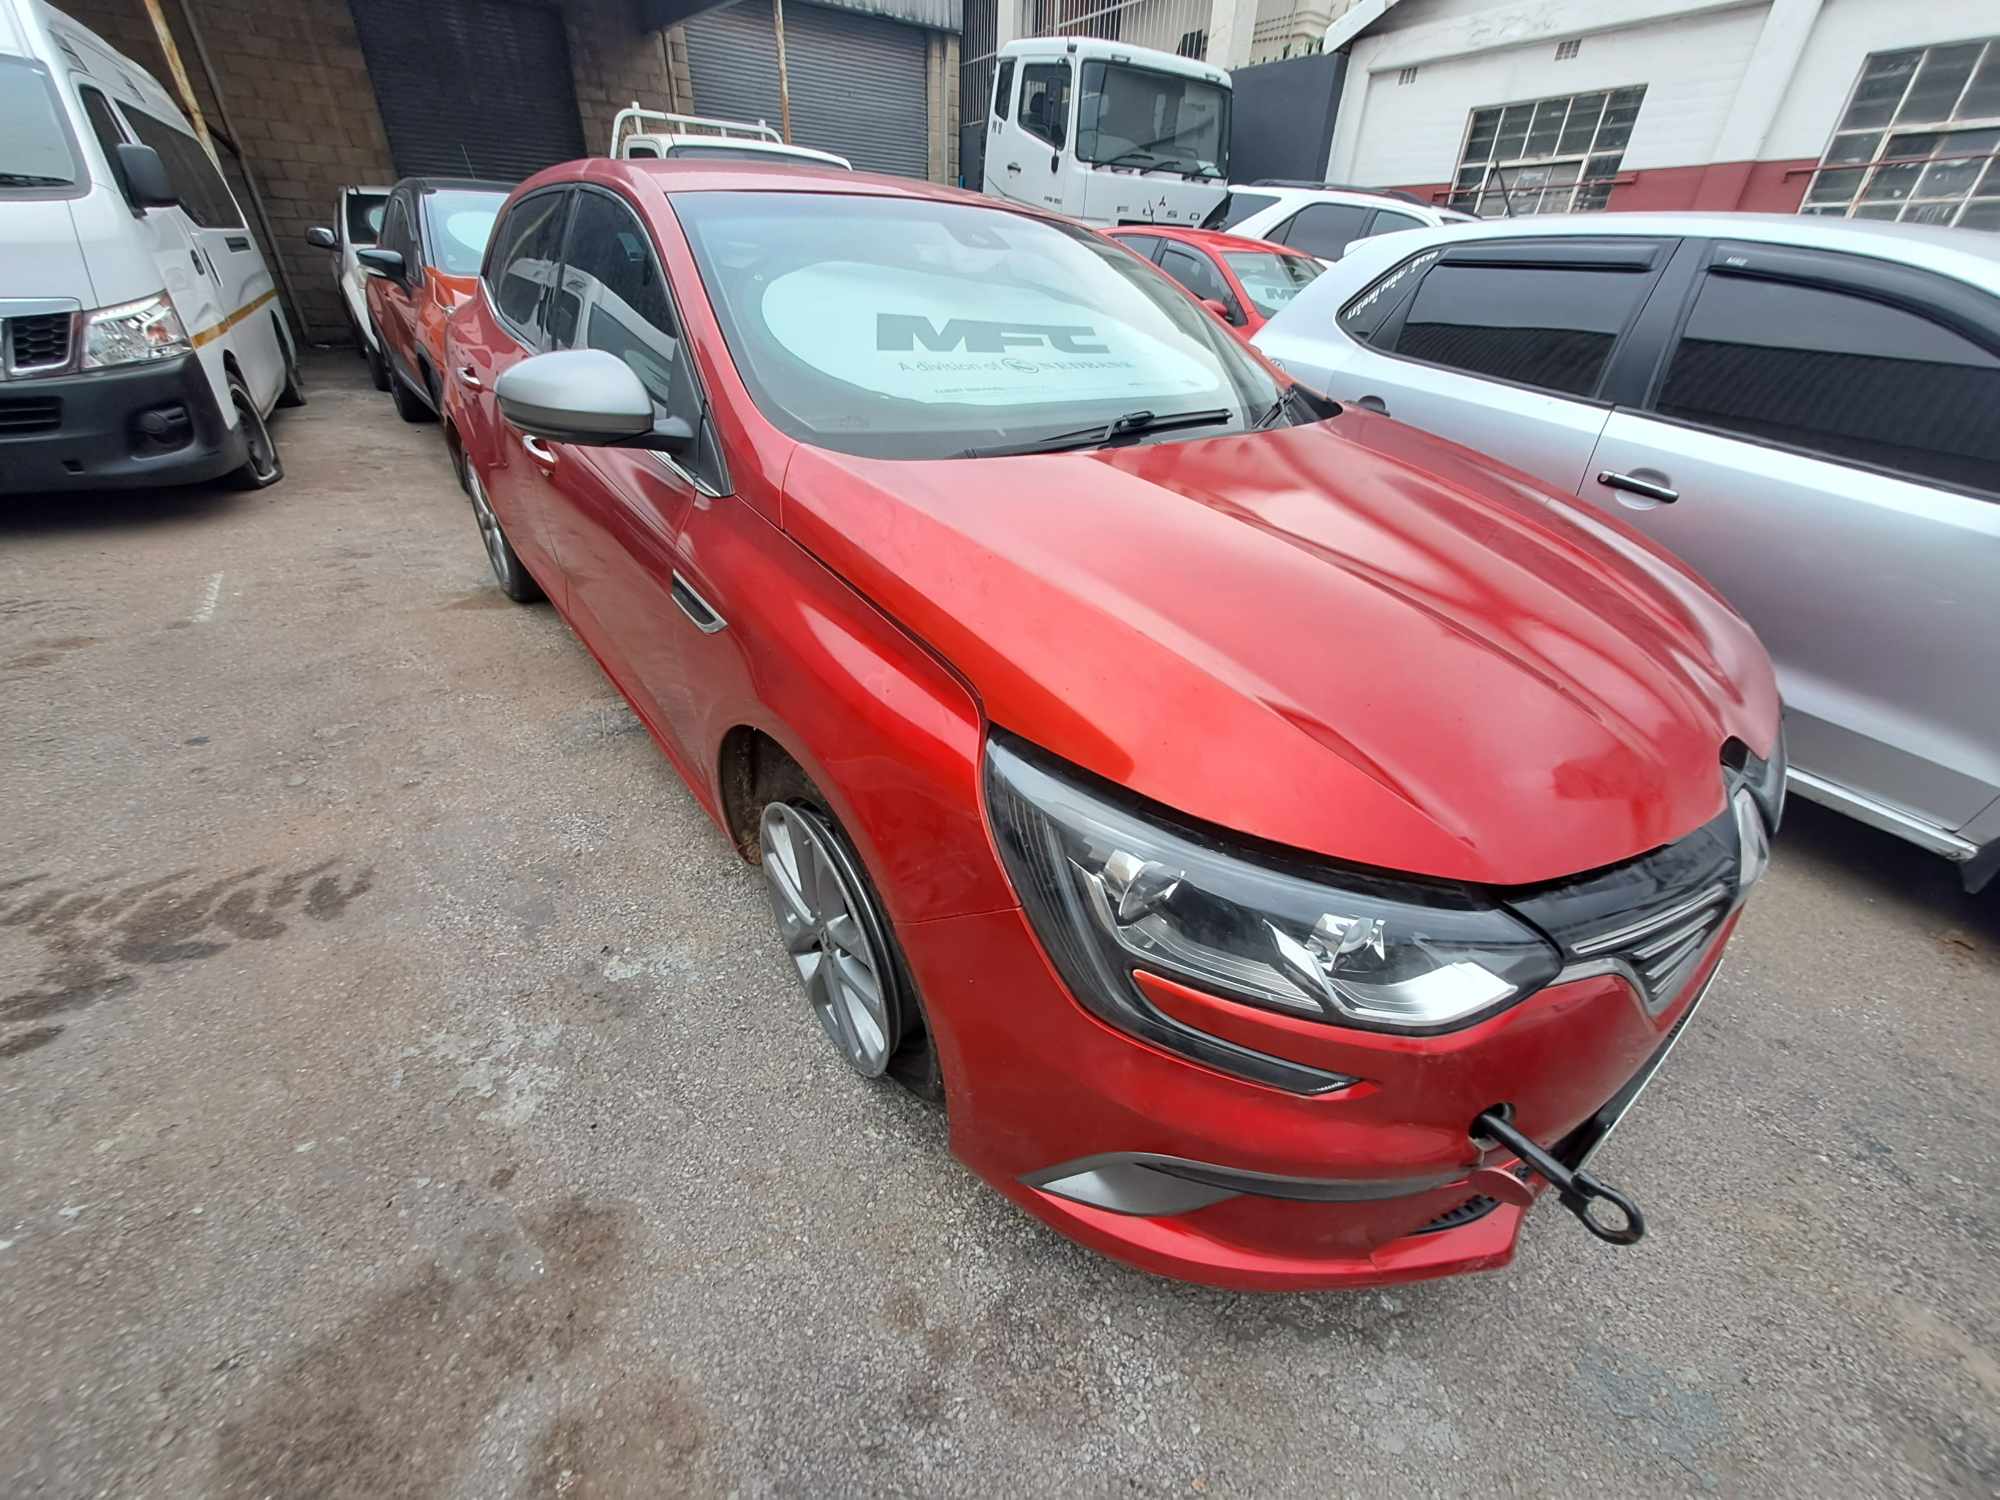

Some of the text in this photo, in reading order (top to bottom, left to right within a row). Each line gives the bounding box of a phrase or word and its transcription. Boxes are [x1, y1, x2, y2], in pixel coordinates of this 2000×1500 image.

[1116, 206, 1201, 221] FUSO
[876, 313, 1110, 354] MFC
[916, 360, 982, 371] division
